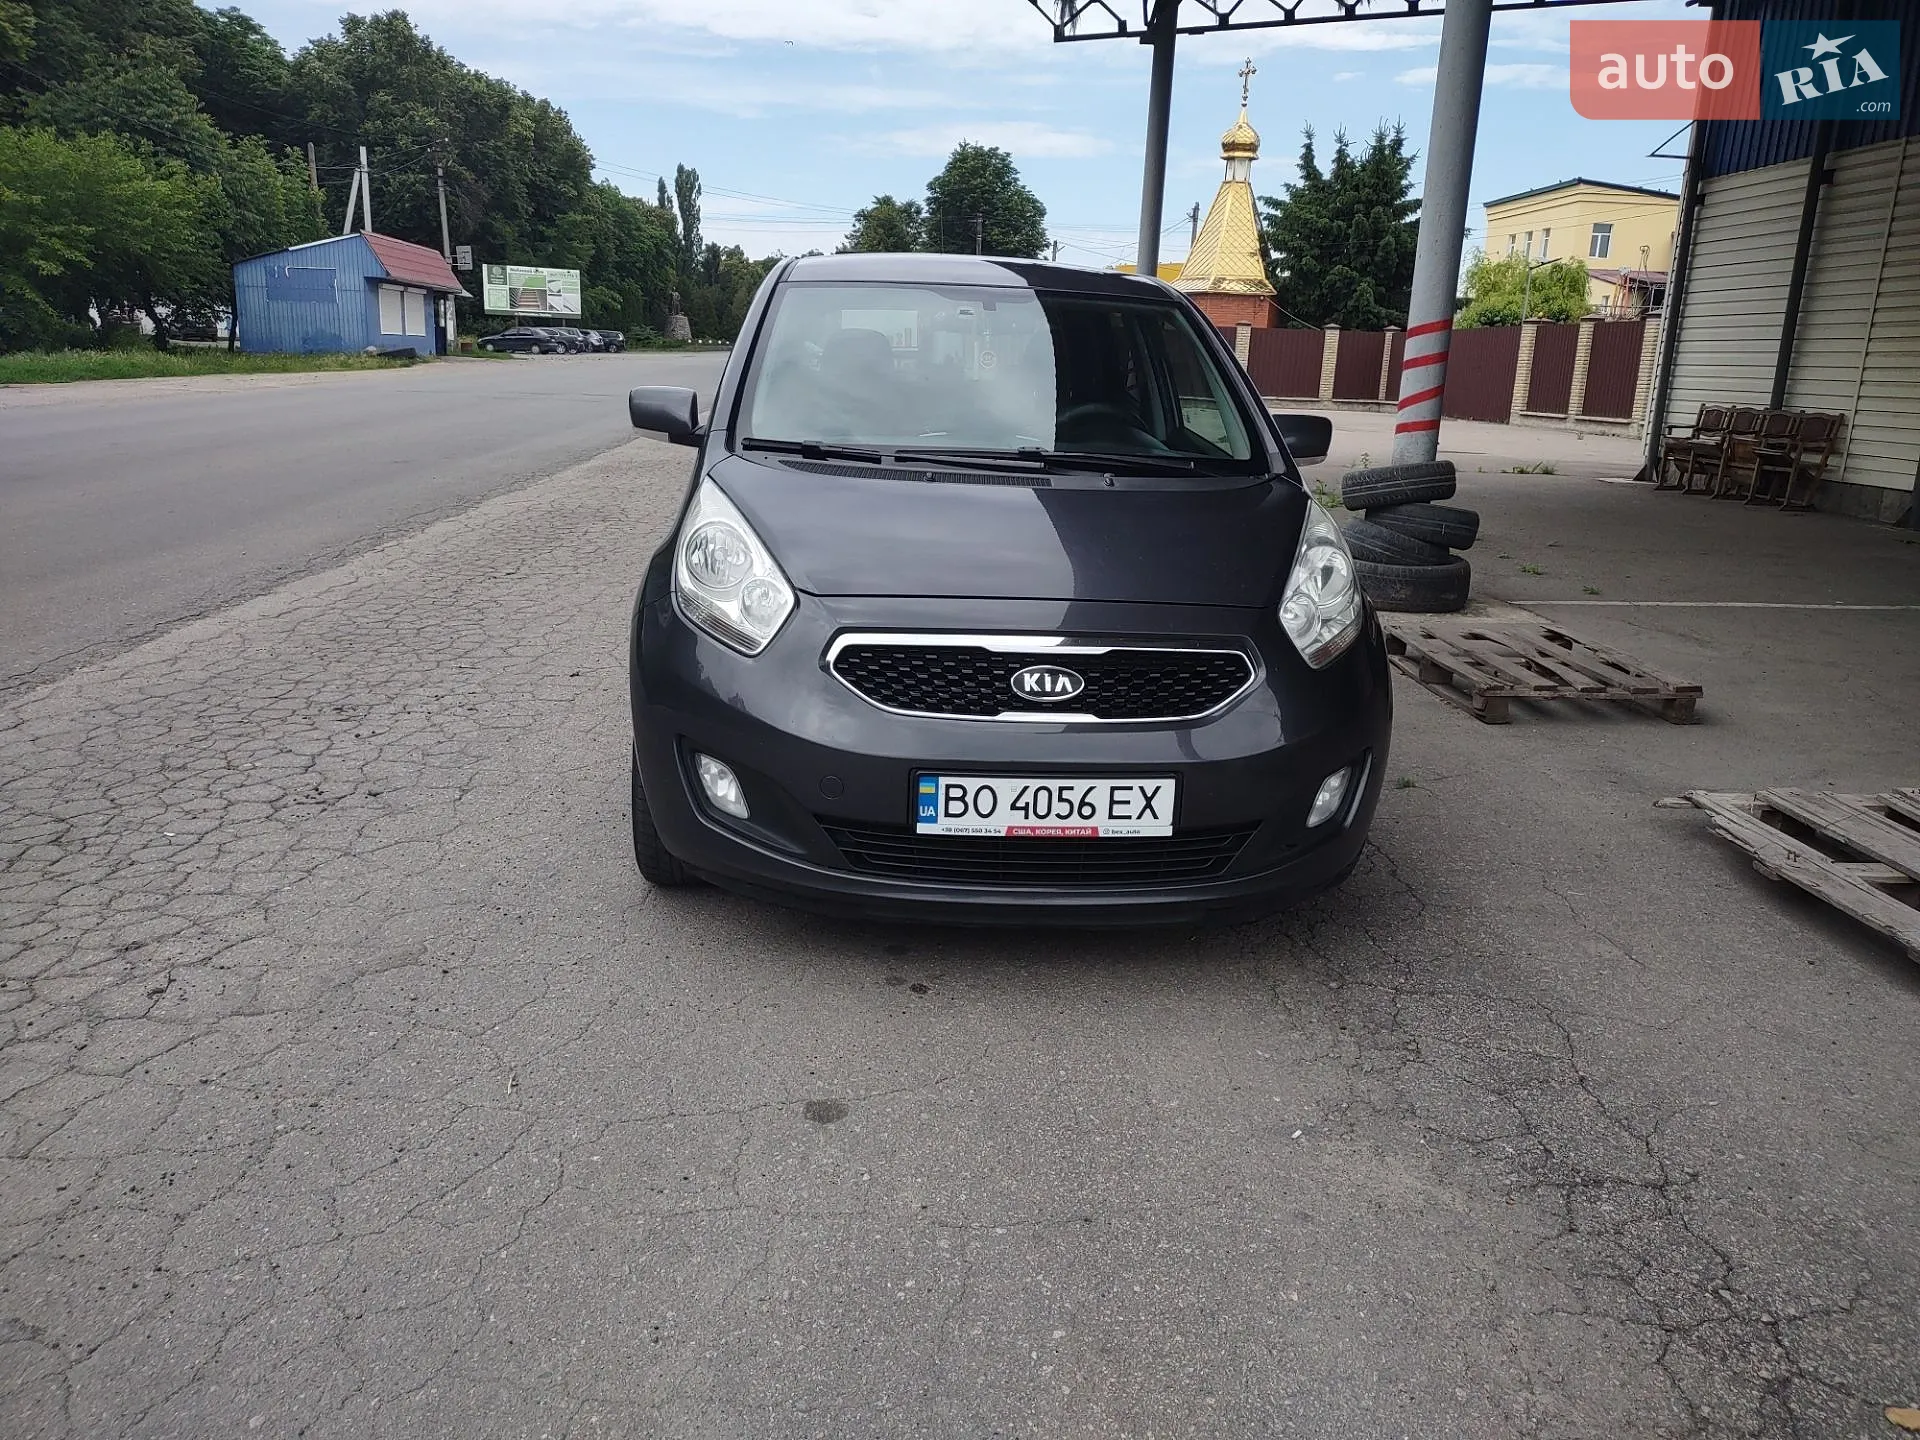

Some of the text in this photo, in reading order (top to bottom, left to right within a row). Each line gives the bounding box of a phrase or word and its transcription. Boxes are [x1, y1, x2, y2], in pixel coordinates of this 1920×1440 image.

[1023, 673, 1073, 692] KIA
[943, 783, 1162, 820] BO 4056 EX
[919, 805, 936, 817] UA
[1012, 828, 1092, 836] США, КОРЕЯ, КИТАЙ
